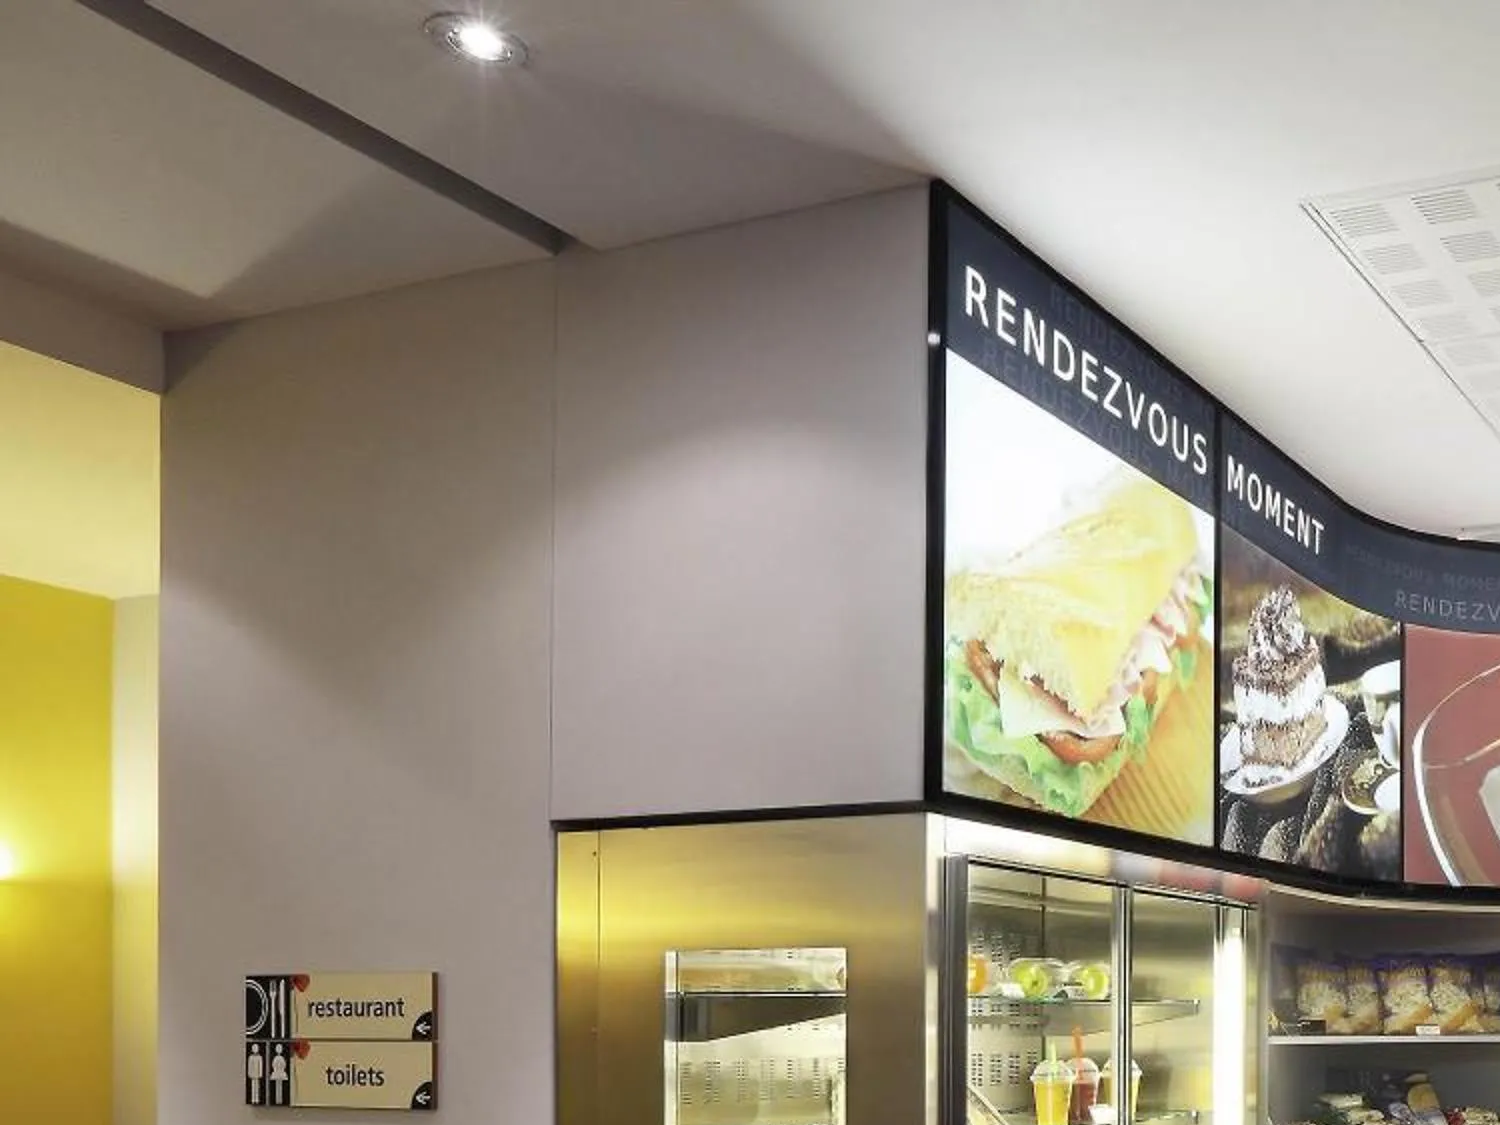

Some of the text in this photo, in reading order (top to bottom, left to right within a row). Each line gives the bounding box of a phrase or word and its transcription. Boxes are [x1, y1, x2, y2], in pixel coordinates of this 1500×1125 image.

[964, 265, 1325, 555] RENDEZVOUS MOMENT
[308, 998, 405, 1017] restaurant
[325, 1064, 385, 1086] toilets
